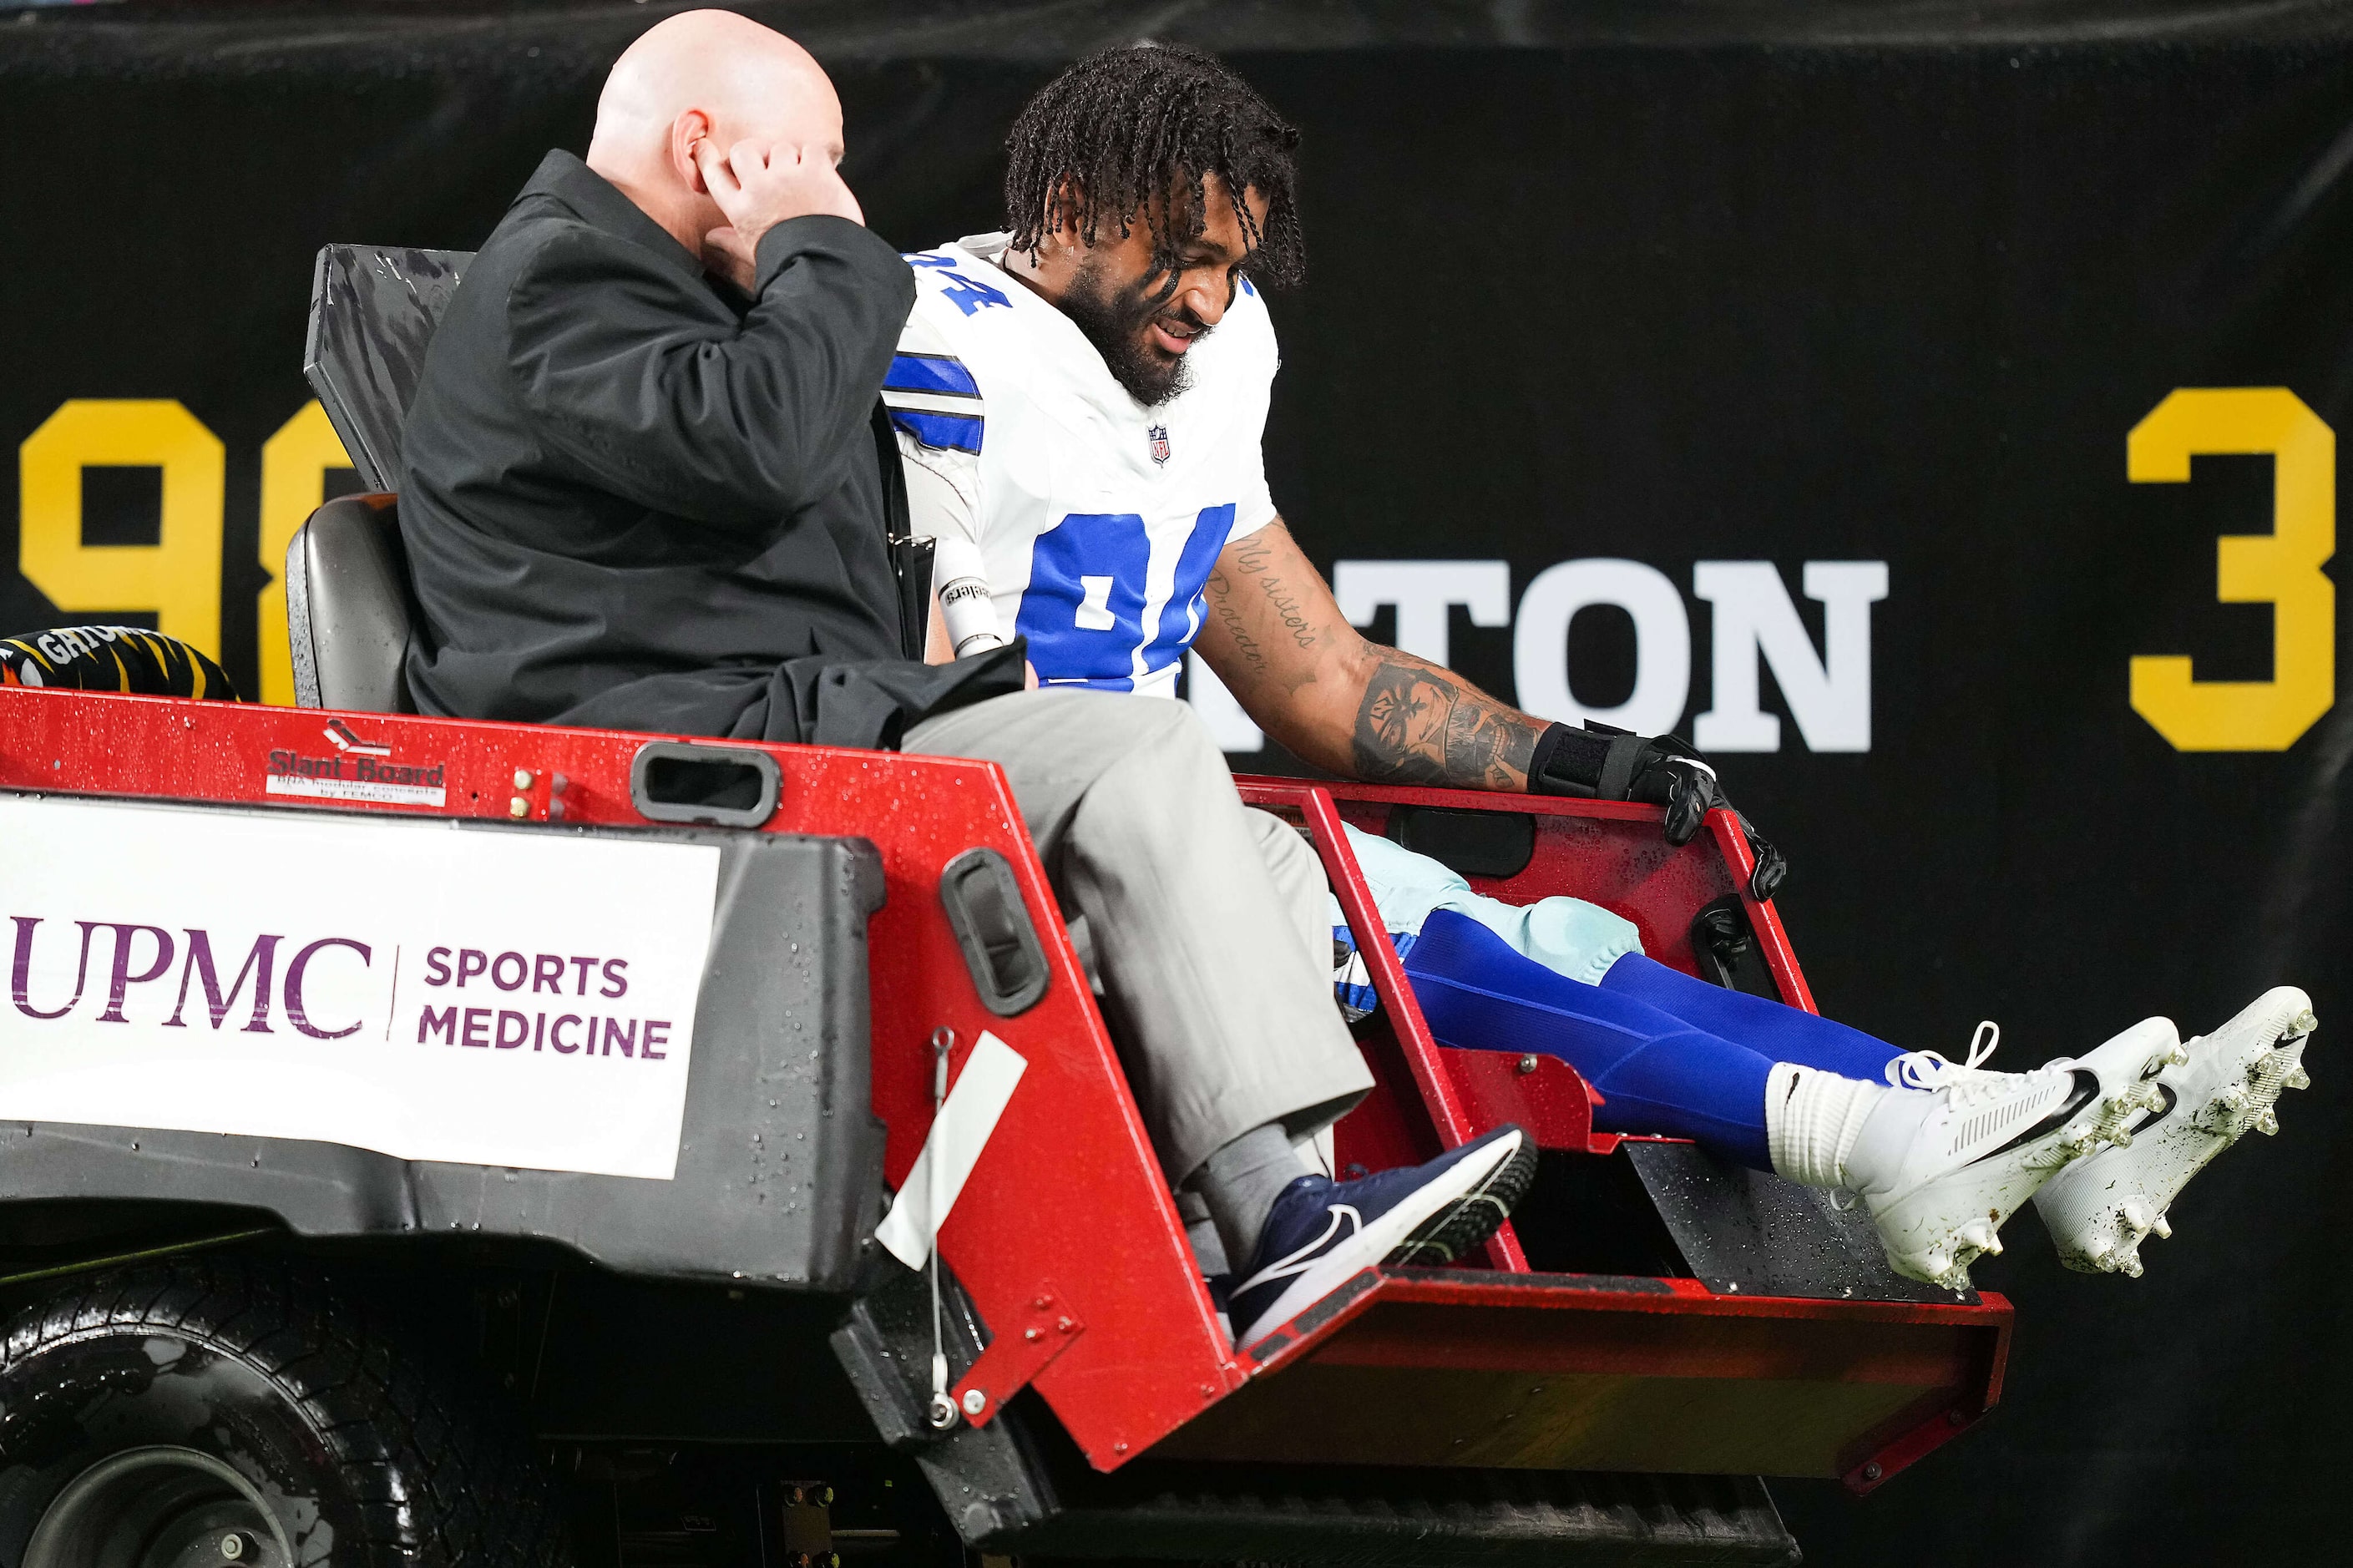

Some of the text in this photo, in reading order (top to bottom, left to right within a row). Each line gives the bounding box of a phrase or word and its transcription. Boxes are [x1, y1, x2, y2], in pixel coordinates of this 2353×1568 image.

[1152, 440, 1169, 459] NFL
[1235, 536, 1317, 650] My sister's
[2127, 387, 2336, 752] 3
[267, 750, 445, 787] Slant Board
[320, 788, 335, 799] by
[10, 915, 372, 1040] UPMC
[424, 946, 629, 999] SPORTS
[417, 1004, 672, 1060] MEDICINE
